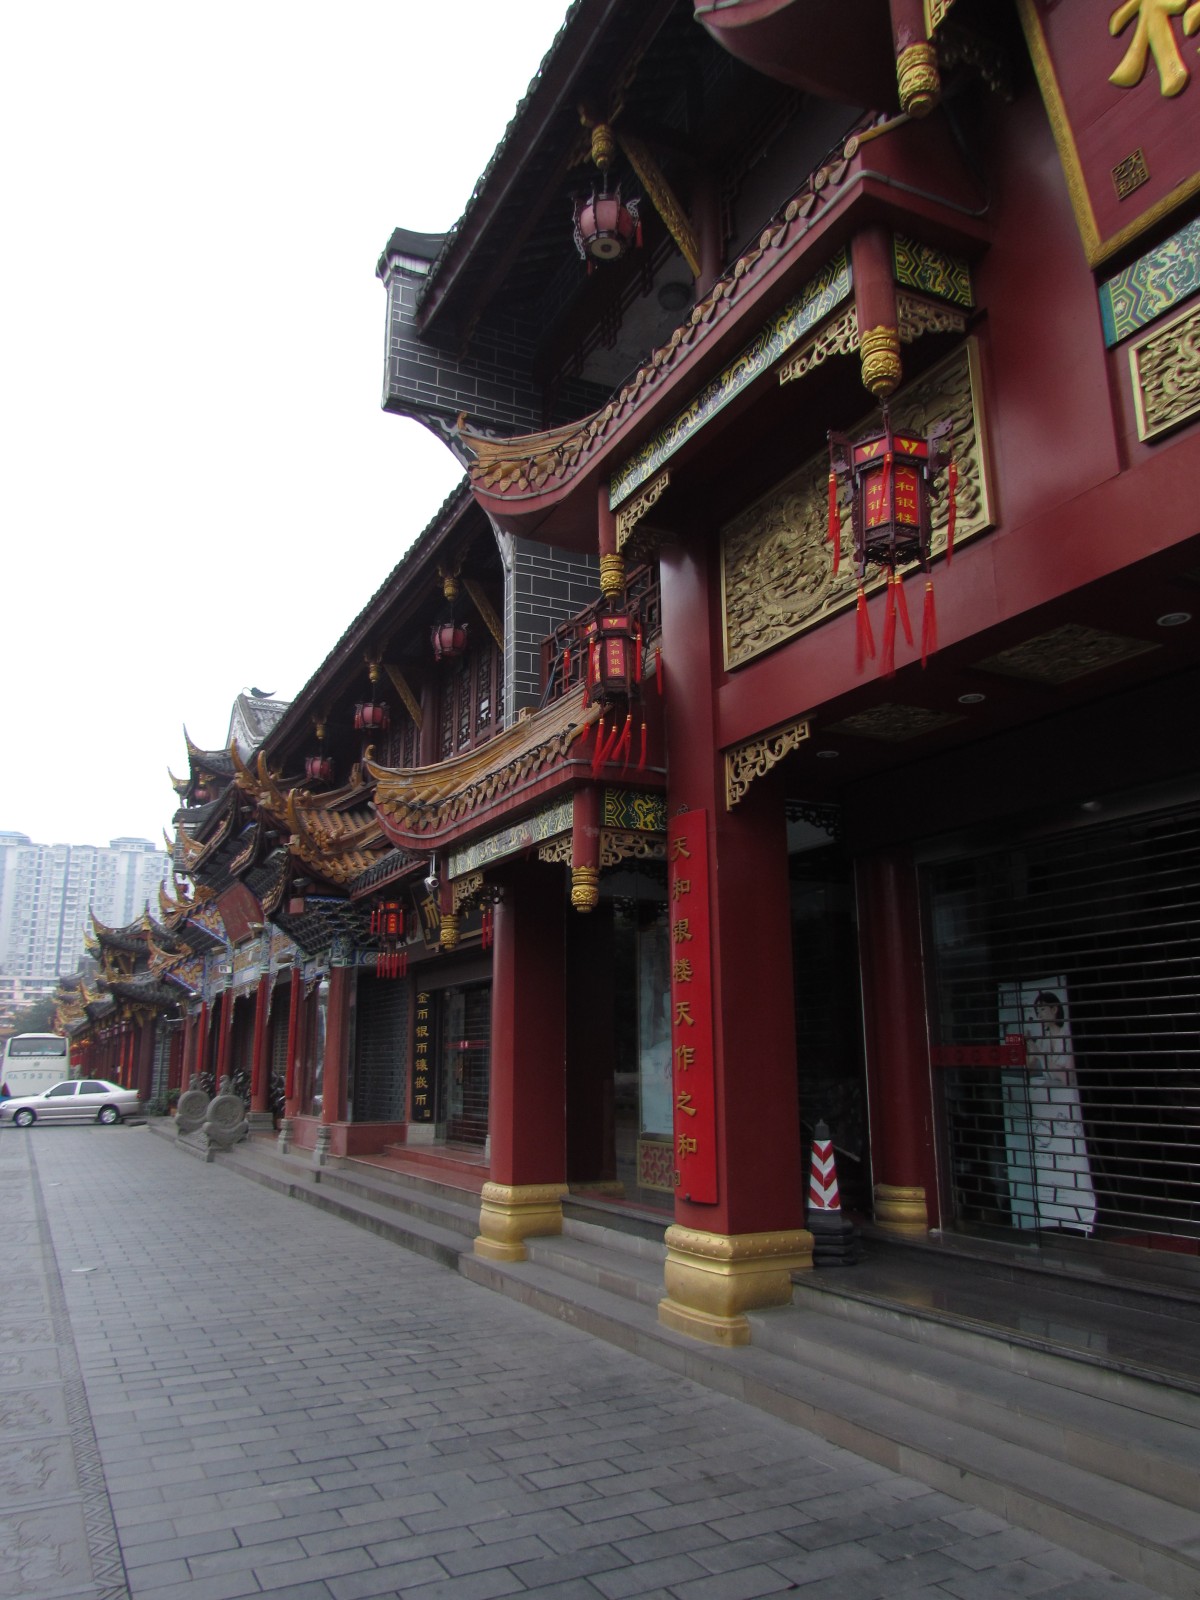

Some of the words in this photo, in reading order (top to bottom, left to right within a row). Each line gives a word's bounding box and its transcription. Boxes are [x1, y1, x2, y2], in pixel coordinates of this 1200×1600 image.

[415, 992, 430, 1106] 金币银币镶嵌币
